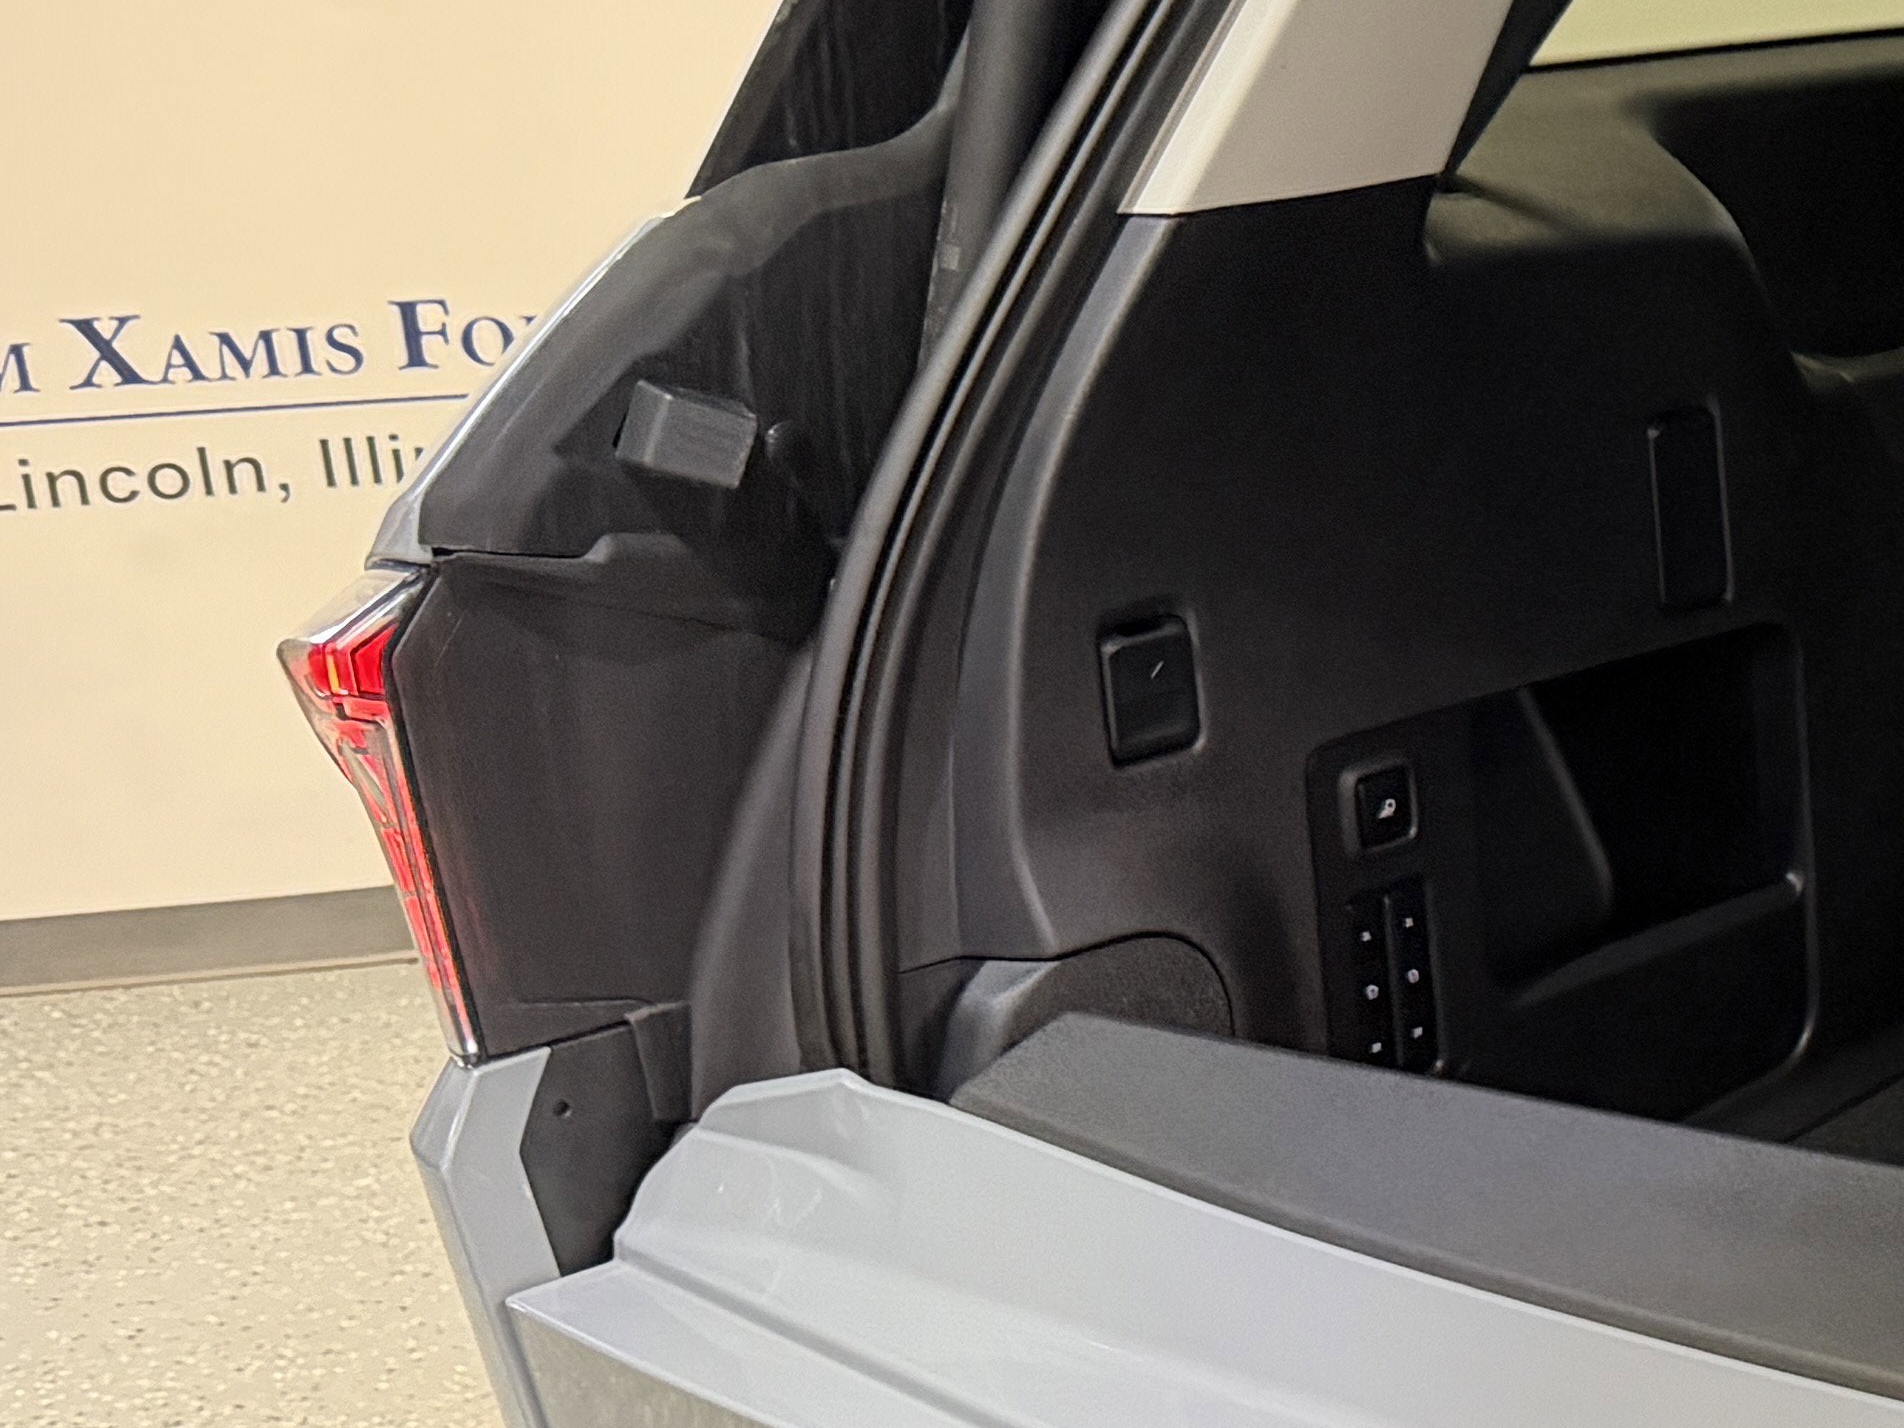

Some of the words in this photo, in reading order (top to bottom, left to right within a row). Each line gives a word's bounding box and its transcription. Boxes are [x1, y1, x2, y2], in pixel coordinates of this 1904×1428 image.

[57, 313, 366, 391] XAMIS
[387, 299, 537, 370] FO
[0, 445, 291, 511] incoln,
[318, 433, 424, 489] Illi
